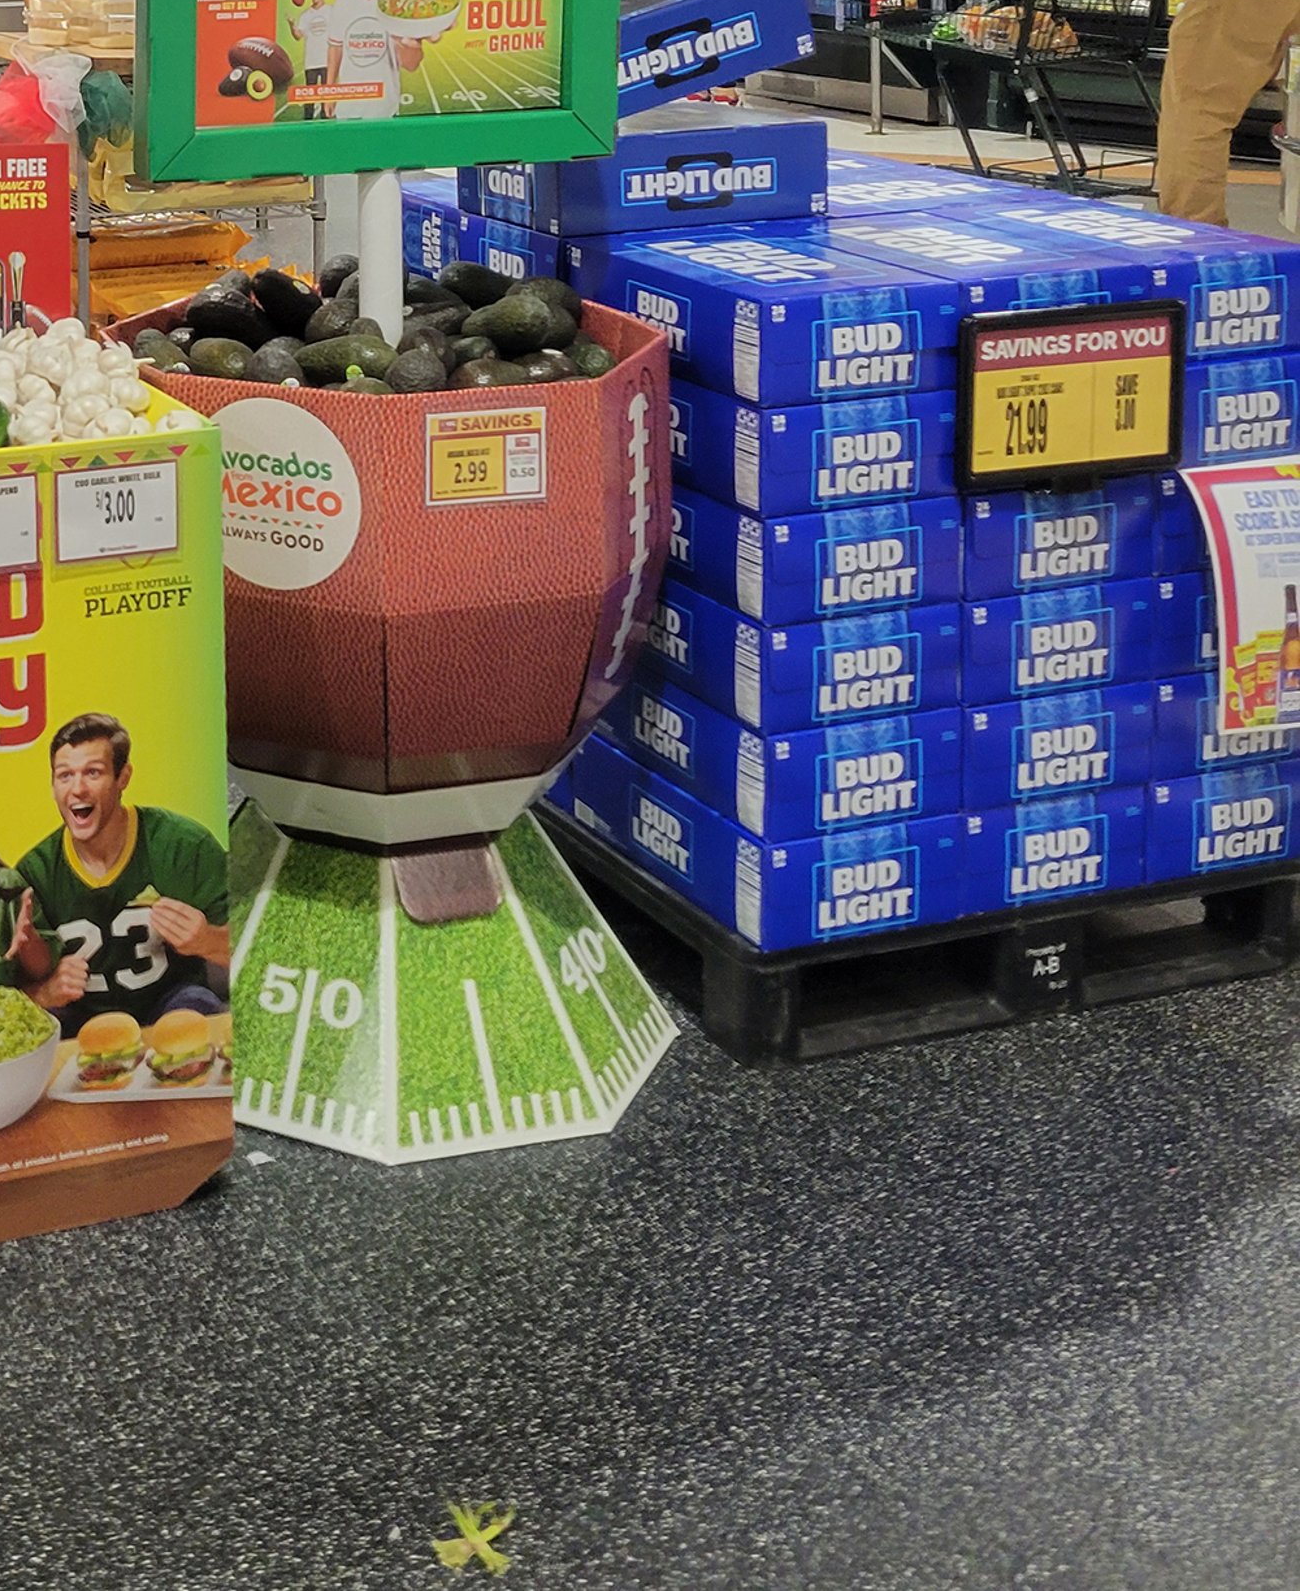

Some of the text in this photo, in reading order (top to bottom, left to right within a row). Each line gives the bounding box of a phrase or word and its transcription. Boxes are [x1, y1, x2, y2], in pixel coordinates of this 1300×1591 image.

[489, 31, 546, 53] GRONK
[6, 159, 47, 177] FREE
[31, 180, 46, 191] TO
[1207, 286, 1270, 317] BUD
[832, 322, 901, 355] BUD
[1195, 314, 1280, 348] LIGHT
[981, 327, 1166, 361] SAVINGS FOR YOU
[818, 354, 913, 387] LIGHT
[1115, 374, 1139, 394] SAVE
[461, 414, 533, 431] SAVINGS
[1006, 398, 1048, 455] 21.99
[454, 460, 488, 484] 2.99
[509, 467, 536, 478] 0.50
[1244, 488, 1298, 508] EASY TO
[1235, 511, 1292, 531] SCORE A
[271, 530, 324, 553] GOOD
[84, 575, 192, 596] COLLEGE FOOTBALL
[85, 587, 192, 618] PLAYOFF
[55, 905, 170, 993] 23
[560, 925, 607, 995] 40
[1032, 956, 1061, 977] A-B
[260, 962, 363, 1028] 50
